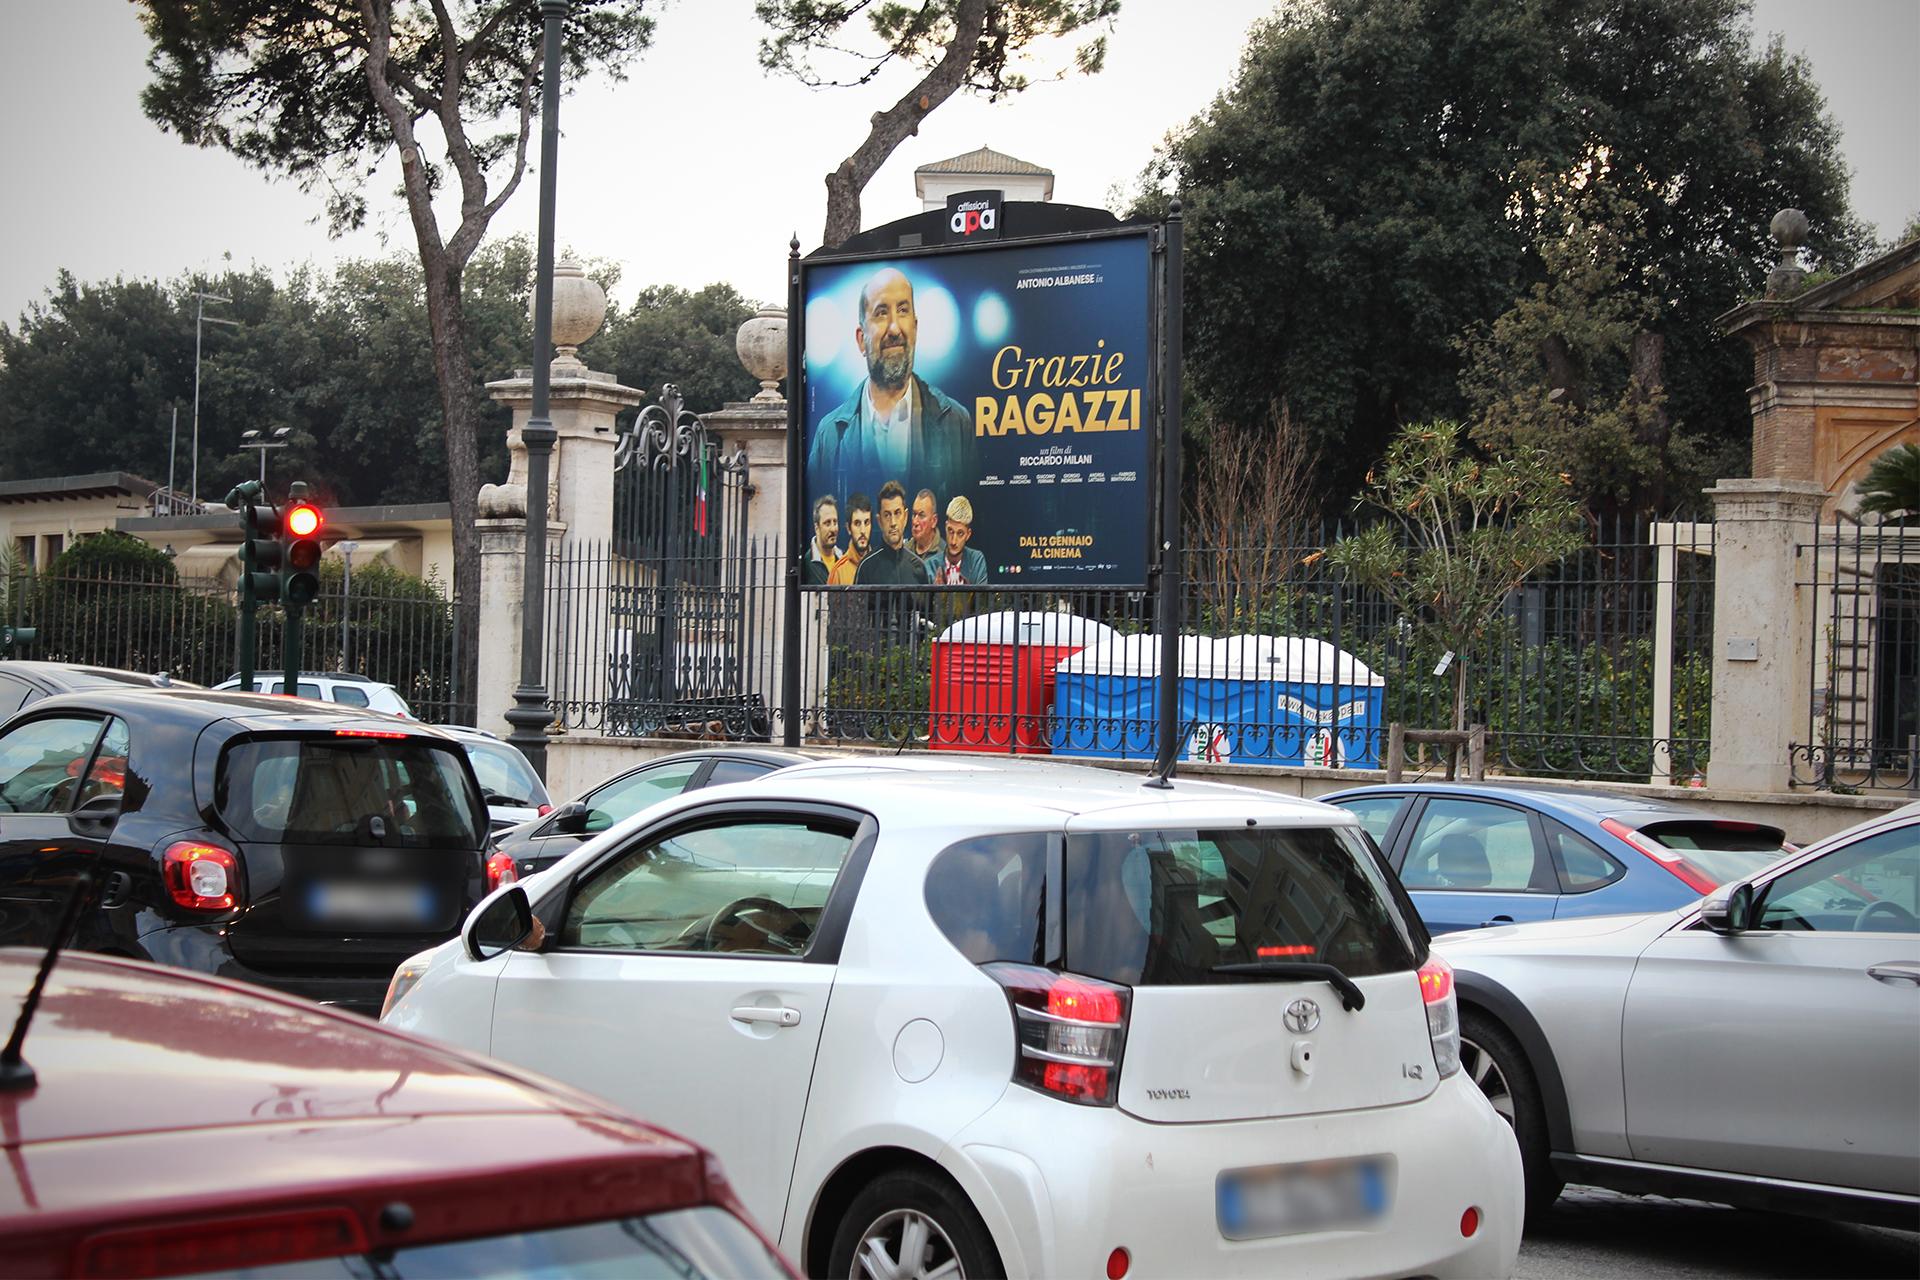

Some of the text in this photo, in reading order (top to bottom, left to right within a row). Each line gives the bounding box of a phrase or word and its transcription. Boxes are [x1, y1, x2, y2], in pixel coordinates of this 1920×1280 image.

[951, 209, 996, 236] apa
[1016, 274, 1104, 290] ANTONIO ALBANESE in
[991, 339, 1125, 390] Grazie
[975, 389, 1141, 437] RAGAZZI
[1049, 446, 1064, 457] film
[1064, 445, 1072, 454] di
[1020, 454, 1093, 466] RICCARDO MILANI
[1019, 535, 1093, 547] DAL 12 GENNAIO
[1031, 547, 1082, 559] AL CINEMA
[1146, 1089, 1191, 1100] TOYOTA
